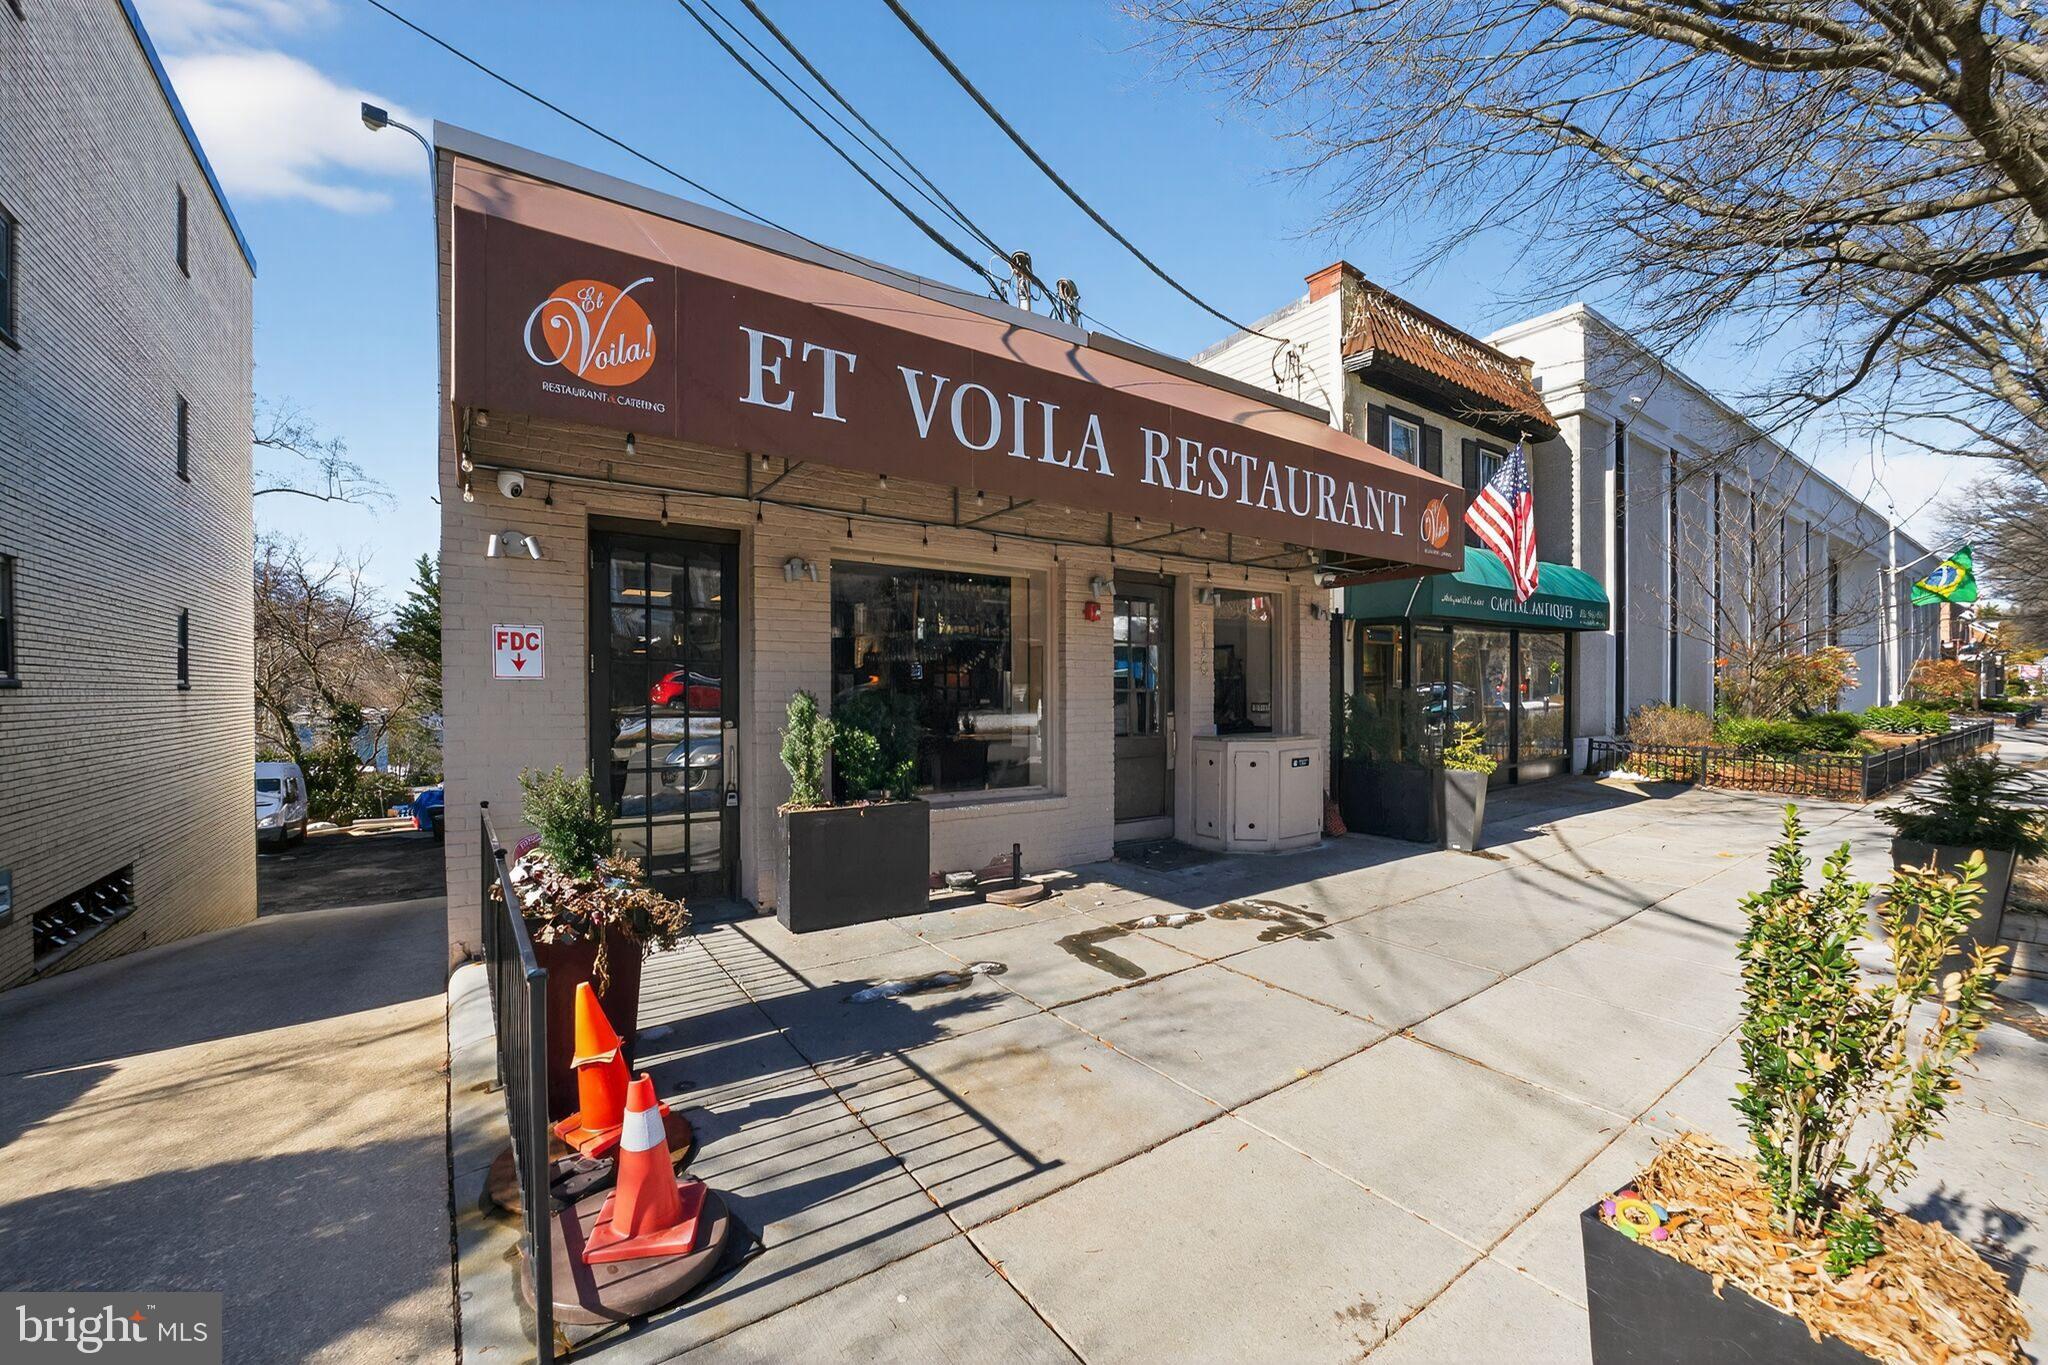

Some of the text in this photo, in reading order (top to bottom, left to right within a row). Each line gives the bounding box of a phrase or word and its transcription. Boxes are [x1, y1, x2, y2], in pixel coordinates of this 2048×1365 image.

[577, 286, 604, 313] Et
[523, 276, 655, 377] Voila!
[542, 380, 608, 403] RESTAURANT
[616, 395, 666, 414] CATERING
[738, 325, 1407, 537] ET VOILA RESTAURANT
[1531, 601, 1574, 621] ANTIQUES
[496, 631, 540, 651] FDC
